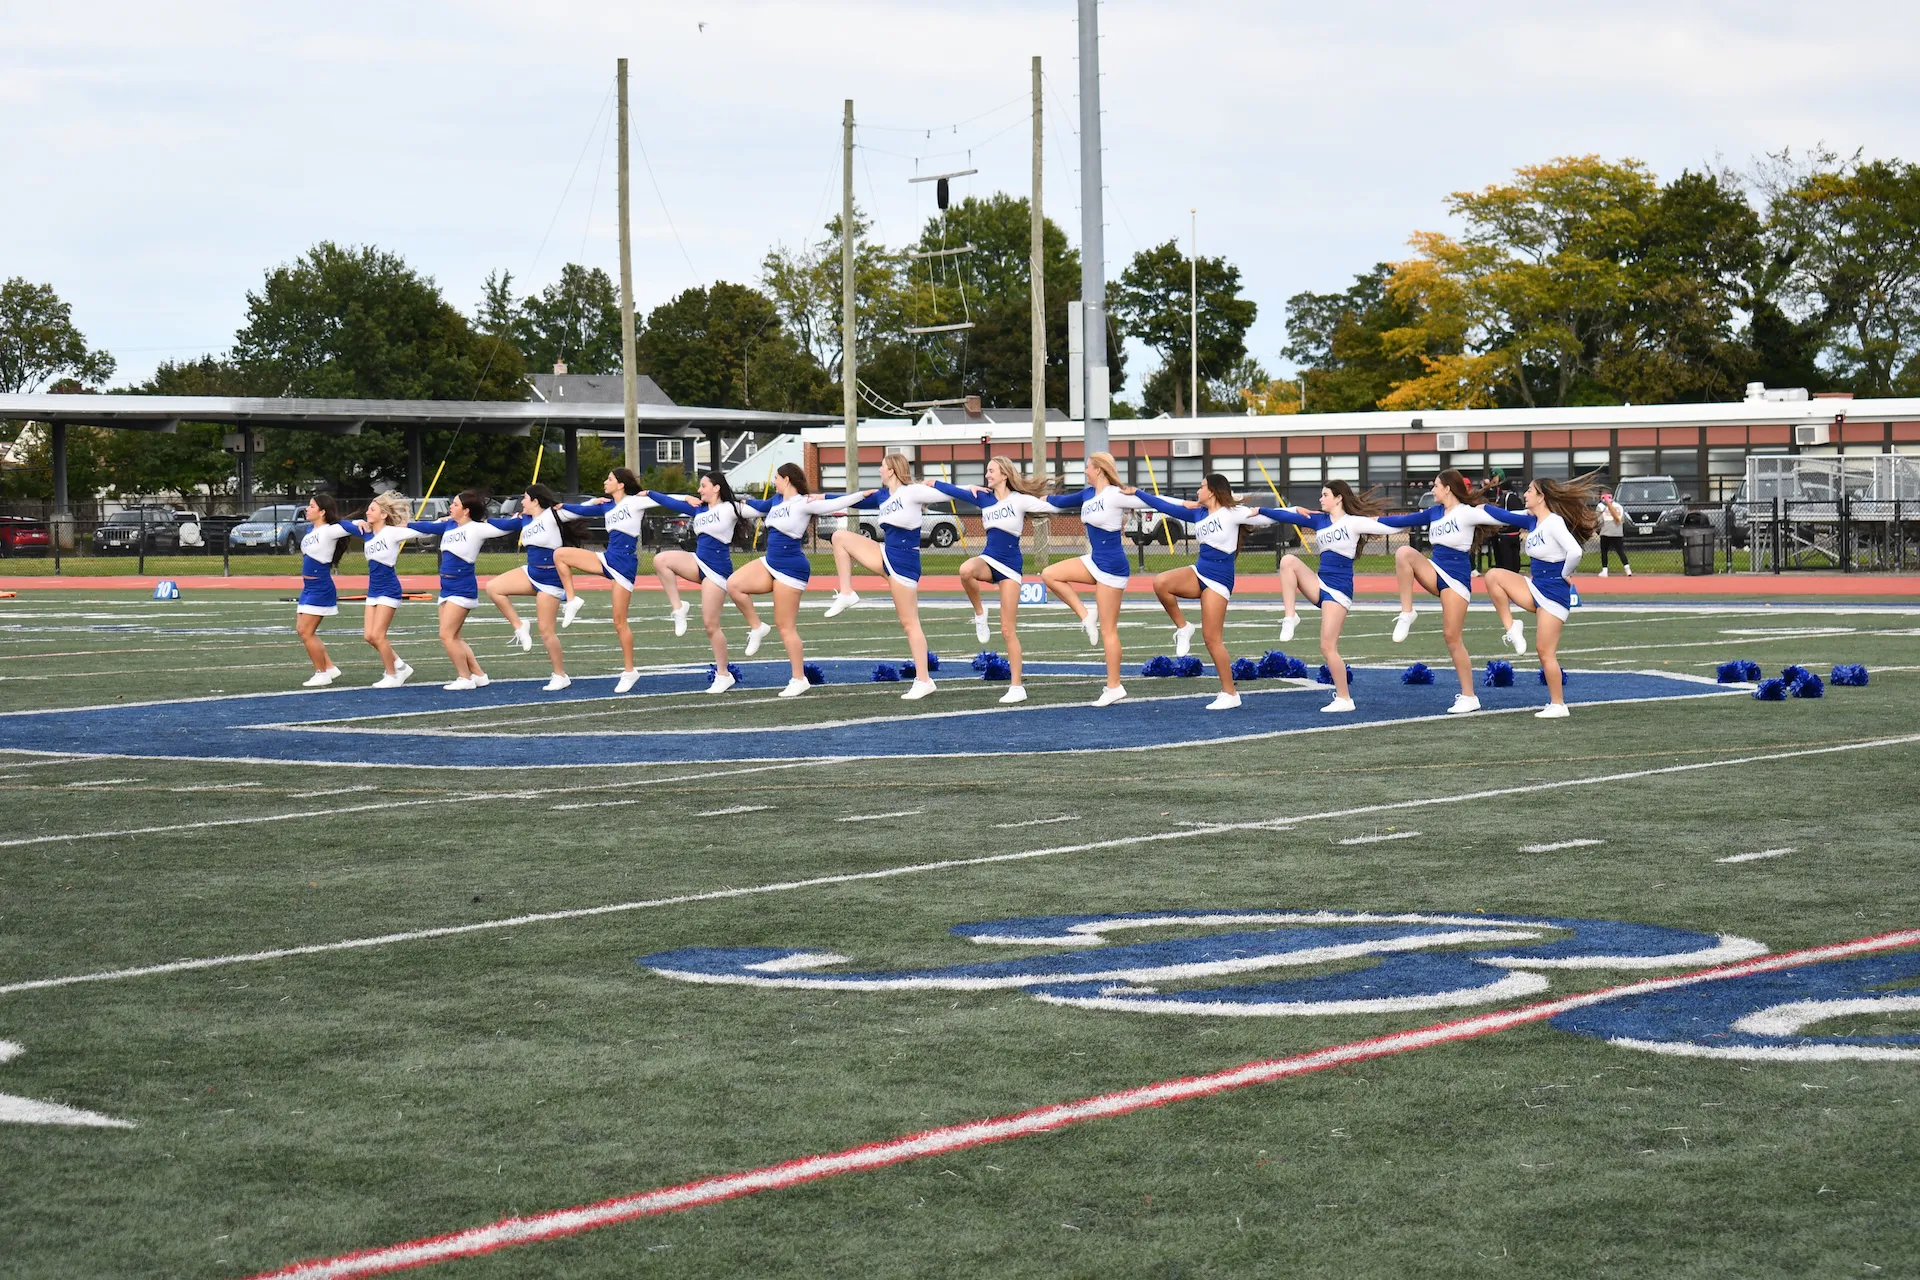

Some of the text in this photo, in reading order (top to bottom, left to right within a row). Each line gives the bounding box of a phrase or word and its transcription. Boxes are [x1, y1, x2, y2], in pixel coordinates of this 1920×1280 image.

[1430, 517, 1460, 537] VISION
[157, 581, 171, 597] 10
[1020, 583, 1042, 602] 30
